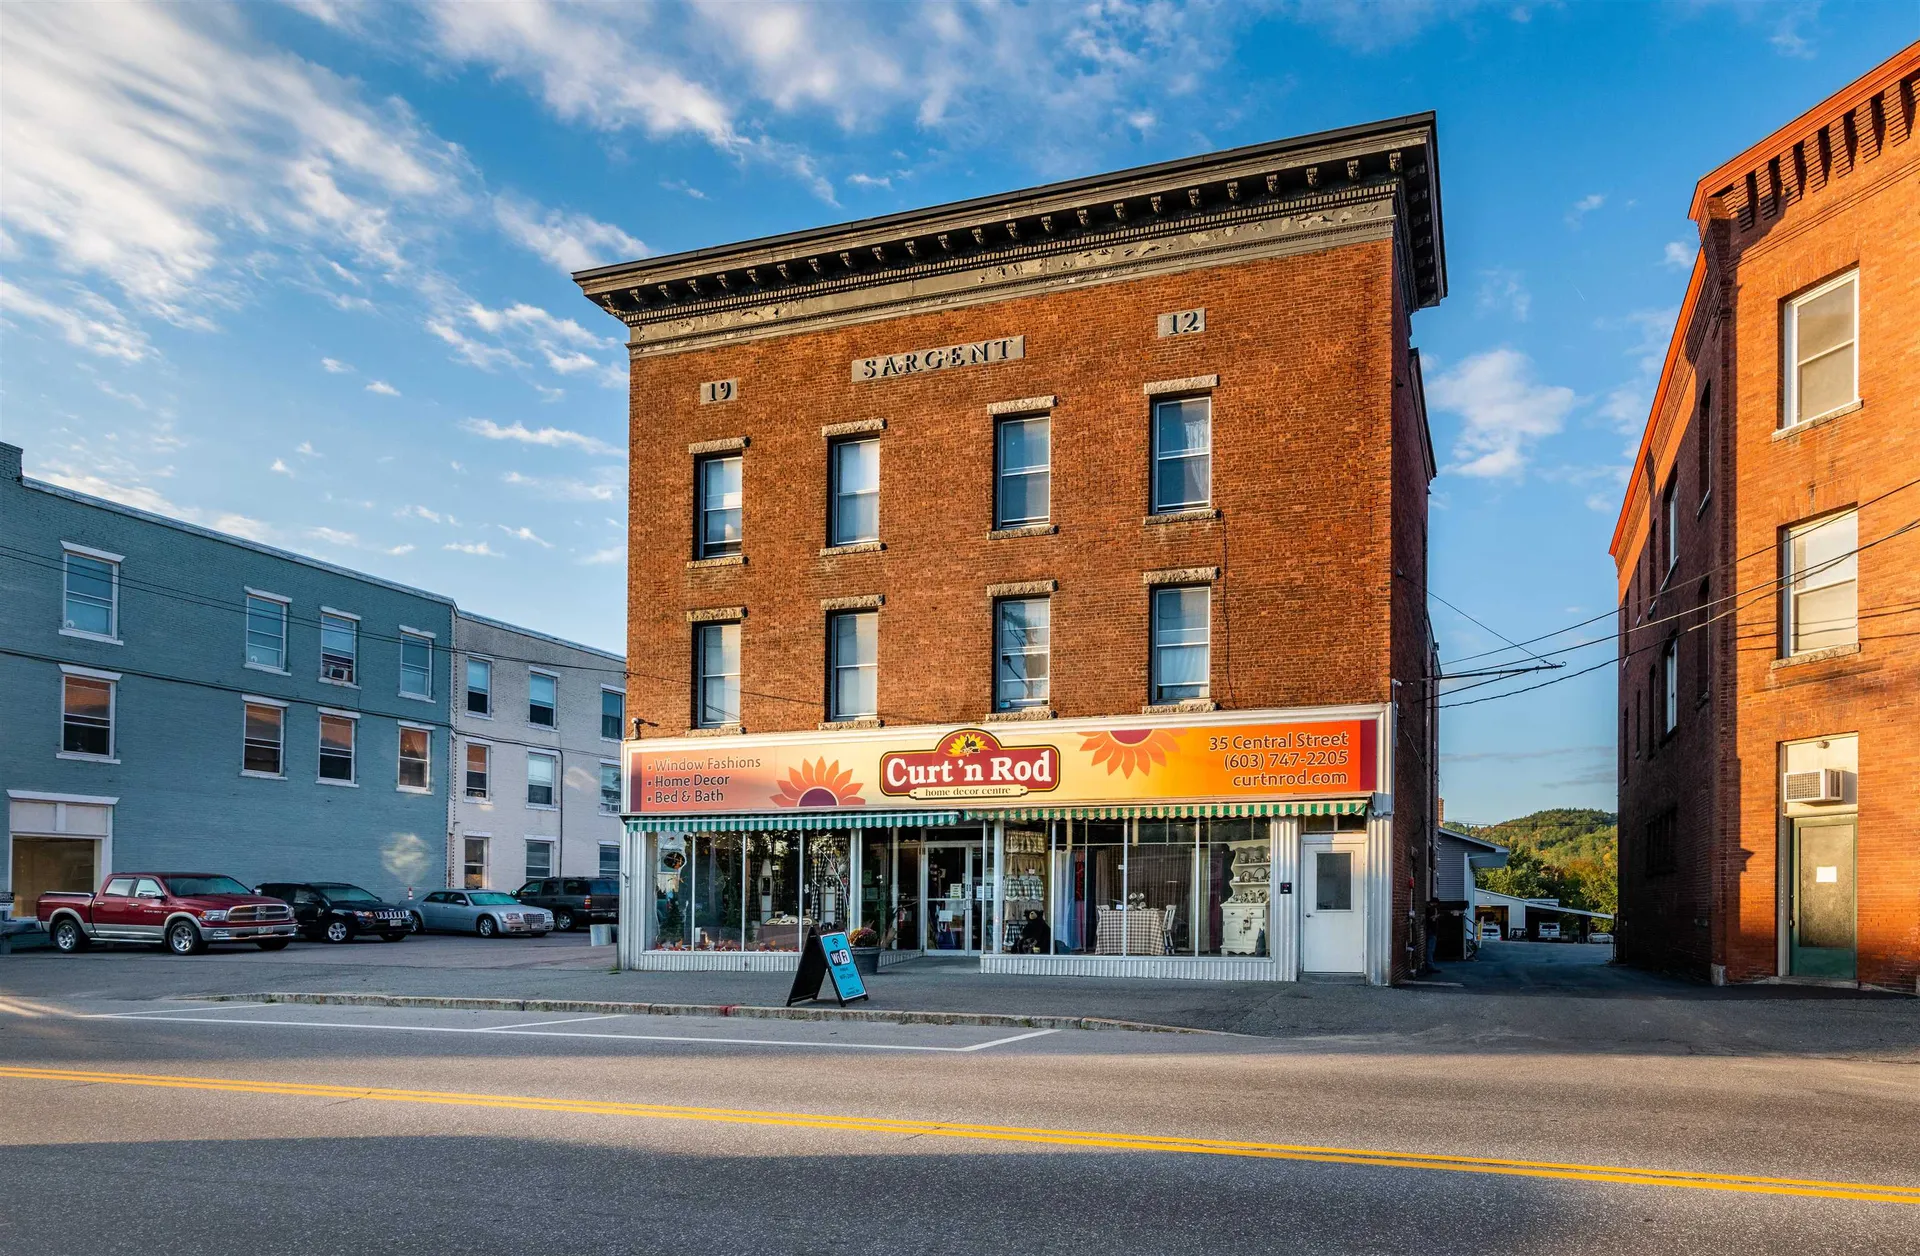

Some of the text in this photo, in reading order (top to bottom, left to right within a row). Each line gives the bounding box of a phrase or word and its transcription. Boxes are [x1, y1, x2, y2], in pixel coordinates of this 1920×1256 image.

[1168, 311, 1200, 335] 12
[863, 338, 1014, 379] SARGENT
[708, 381, 732, 401] 19
[1209, 731, 1349, 751] 35 Central Street
[655, 756, 761, 772] Window Fashions
[886, 757, 954, 787] Curt
[990, 749, 1052, 782] Rod
[1224, 750, 1348, 771] (603) 747-2205
[655, 774, 730, 787] Home Decor
[1233, 769, 1348, 787] curtnrod.com
[655, 789, 724, 803] Bed & Bath
[925, 786, 1011, 797] home decor centre
